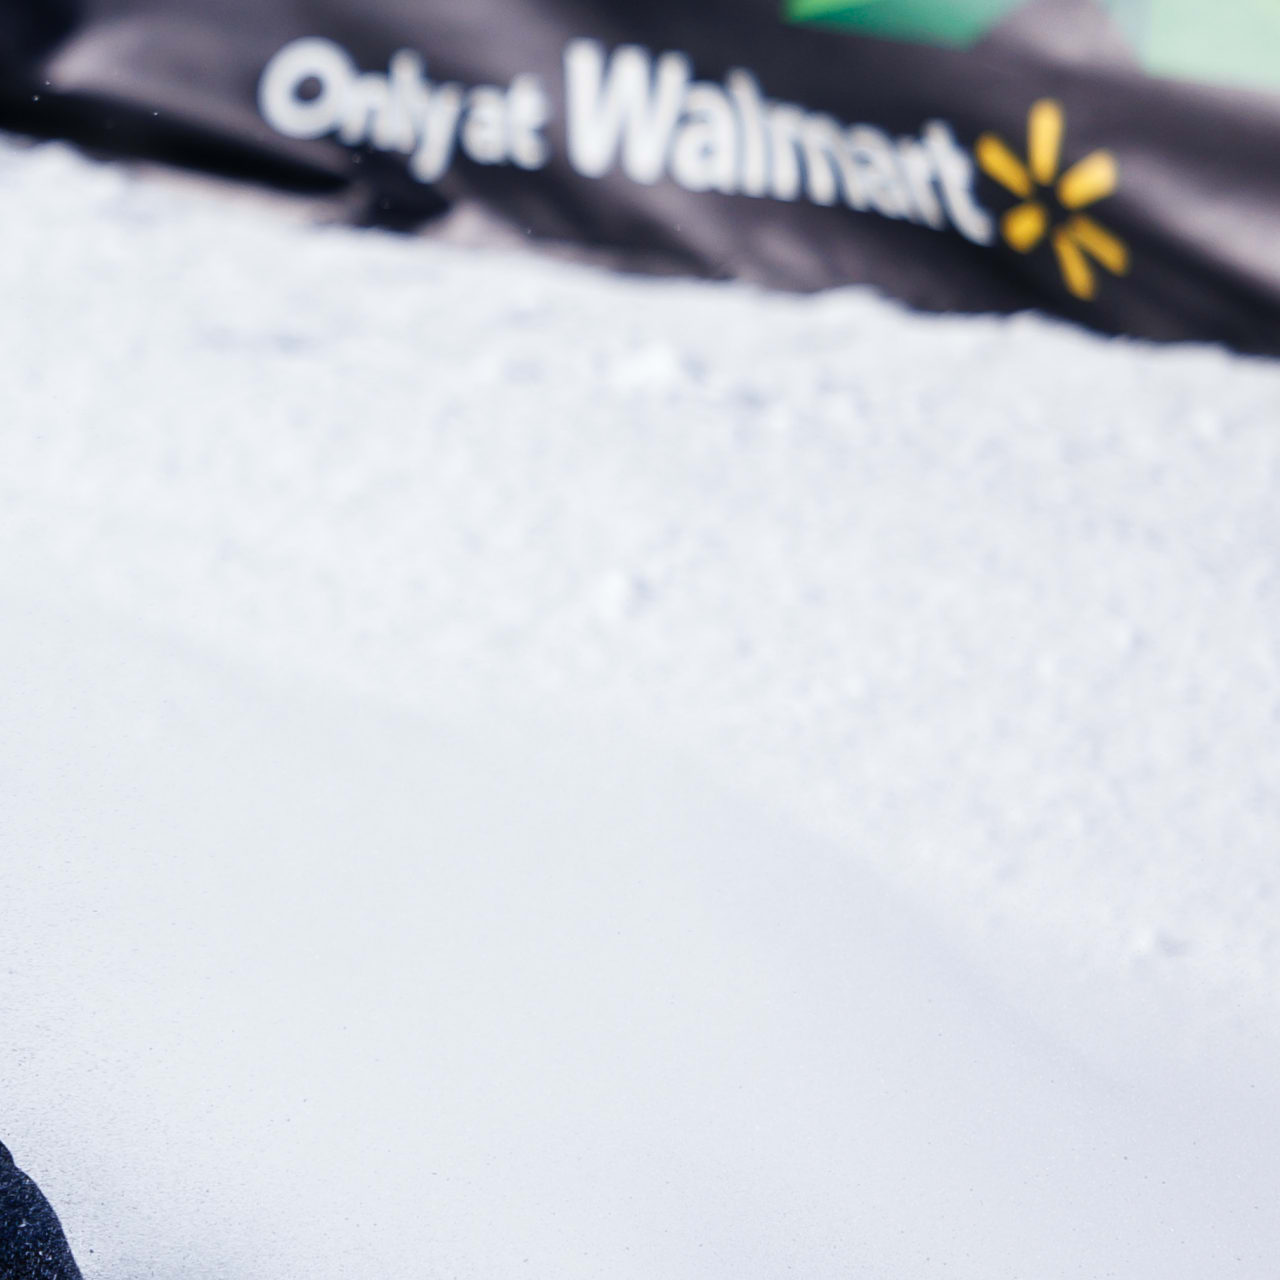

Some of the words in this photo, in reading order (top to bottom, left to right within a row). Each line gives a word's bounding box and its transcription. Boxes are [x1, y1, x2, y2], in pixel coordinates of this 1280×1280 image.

[259, 36, 456, 184] Only
[460, 73, 549, 171] at
[562, 37, 996, 245] Walmart
